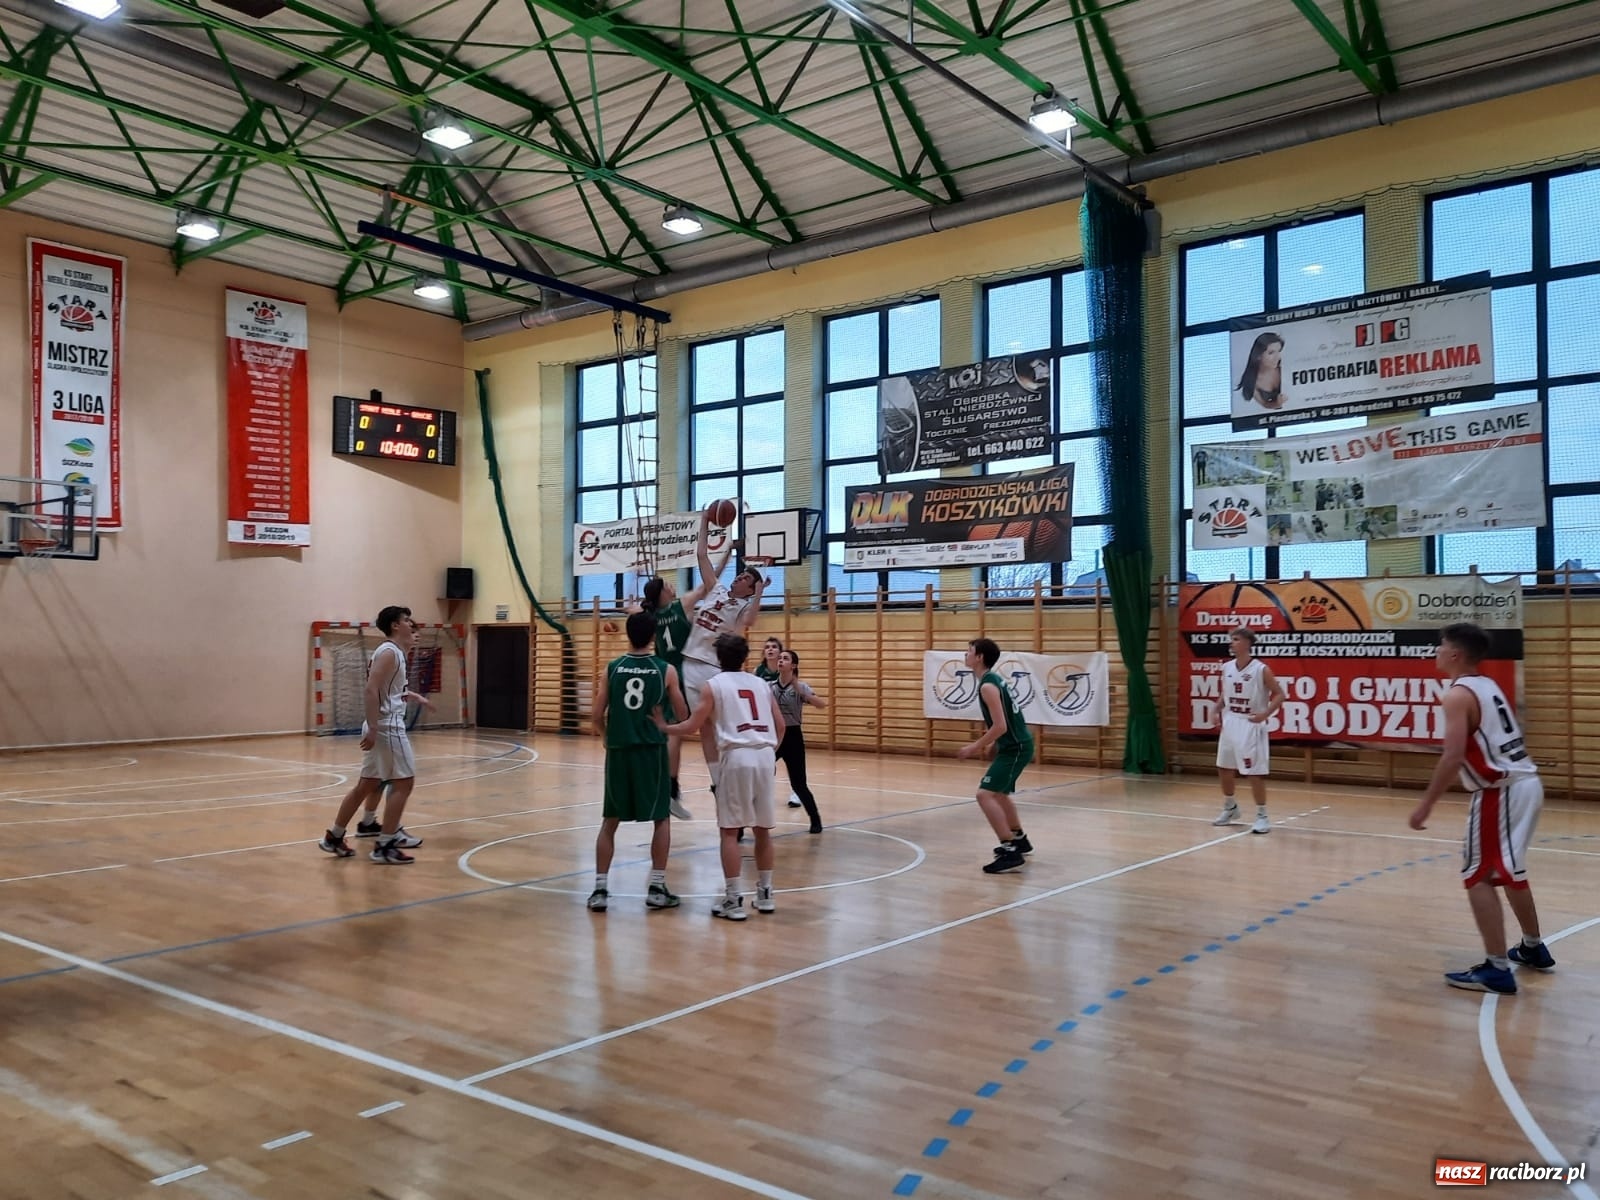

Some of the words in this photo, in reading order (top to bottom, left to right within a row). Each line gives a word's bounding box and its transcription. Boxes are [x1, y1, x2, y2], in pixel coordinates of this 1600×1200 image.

[64, 269, 74, 278] KS
[75, 271, 93, 281] START
[48, 294, 108, 320] START
[246, 301, 283, 319] START
[1266, 312, 1293, 323] STRONY
[1323, 302, 1349, 313] ULOTKI
[1357, 292, 1401, 307] WIZYTÓWKI
[48, 341, 109, 369] MISTRZ
[1292, 359, 1378, 386] FOTOGRAFIA
[1380, 343, 1482, 378] REKLAMA
[52, 390, 64, 410] 3
[68, 391, 105, 414] LIGA
[924, 408, 955, 419] STALI
[959, 393, 1042, 413] NIERDZEWNEJ
[360, 416, 370, 429] 0
[396, 424, 401, 433] 1
[426, 424, 436, 438] 0
[925, 426, 969, 439] TOCZENIE
[983, 415, 1043, 430] FREZOWANIE
[1296, 446, 1329, 465] WE
[1331, 426, 1407, 464] LOVE
[1407, 426, 1457, 447] THIS
[1468, 412, 1530, 438] GAME
[355, 440, 365, 452] 0
[427, 448, 436, 460] 0
[985, 442, 1004, 455] 663
[1005, 440, 1024, 452] 440
[1026, 437, 1045, 450] 622
[925, 481, 1035, 503] DOBRODZIEŃSKA
[1038, 476, 1069, 493] LIGA
[851, 490, 914, 530] DLK
[920, 491, 1069, 523] KOSZYKÓWKI
[1198, 496, 1263, 524] START
[603, 526, 635, 539] PORTAL
[638, 519, 696, 536] TERNETOWY
[1418, 590, 1517, 608] Dobrodzień
[1196, 611, 1273, 629] Drużynę
[662, 625, 678, 651] 1
[1190, 633, 1208, 645] KS
[1210, 633, 1233, 645] STA
[1254, 633, 1301, 644] MEBLE
[1302, 630, 1395, 644] DOBRODZIEŃ
[1299, 643, 1397, 657] KOSZYKÓWKI
[1190, 660, 1223, 674] wspi
[623, 677, 645, 711] 8
[1327, 677, 1340, 700] I
[1350, 677, 1452, 703] GMIN
[737, 689, 760, 721] 7
